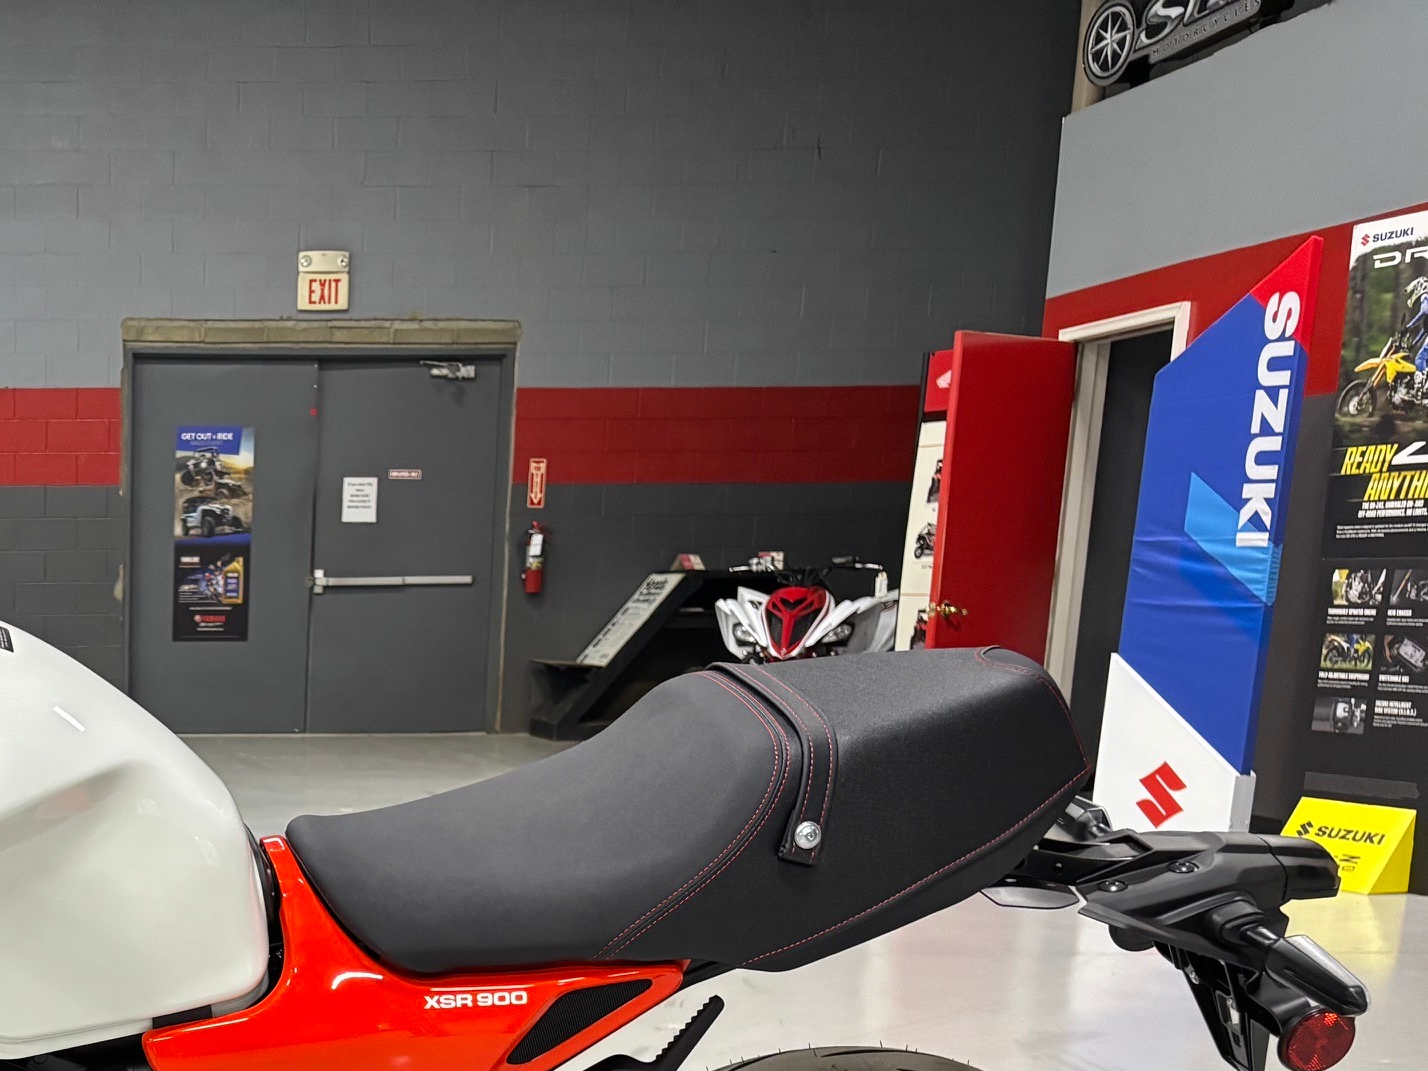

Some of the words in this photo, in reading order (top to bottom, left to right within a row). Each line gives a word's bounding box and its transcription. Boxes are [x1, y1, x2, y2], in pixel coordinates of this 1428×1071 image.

[1372, 227, 1414, 243] SUZUKI
[308, 278, 342, 305] EXIT
[1235, 291, 1301, 548] SUZUKI
[1340, 444, 1399, 475] READY
[1315, 825, 1386, 846] SUZUKI
[424, 993, 474, 1010] XSR
[476, 991, 528, 1007] 900
